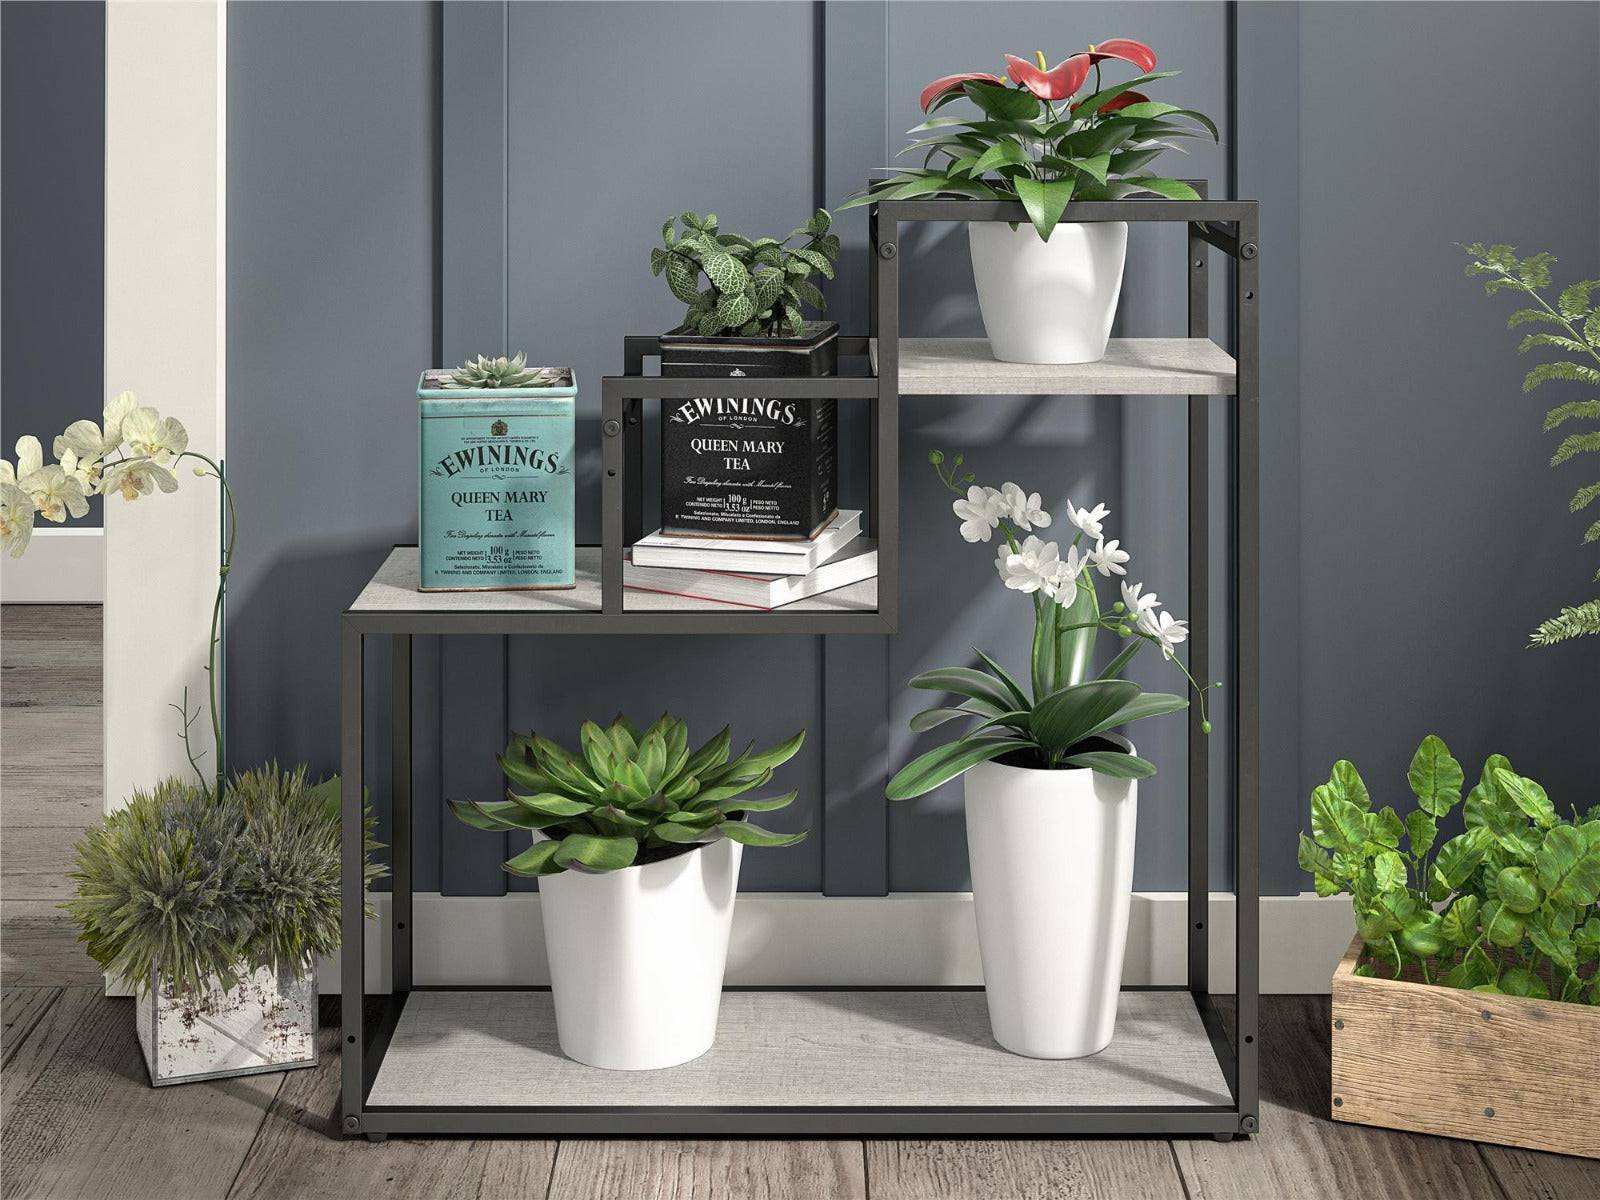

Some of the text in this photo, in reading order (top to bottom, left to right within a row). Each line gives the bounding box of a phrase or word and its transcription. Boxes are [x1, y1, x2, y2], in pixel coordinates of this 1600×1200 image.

[677, 397, 796, 425] EWININGS
[729, 415, 758, 423] LONDON
[690, 438, 785, 455] QUEEN MARY
[438, 445, 559, 478] EWININGS
[723, 457, 751, 471] TEA
[451, 491, 548, 508] QUEEN MARY
[728, 494, 747, 505] 100 g
[725, 503, 740, 512] 3.53
[485, 509, 514, 522] TEA
[490, 545, 503, 555] 100
[486, 555, 502, 564] 3.53
